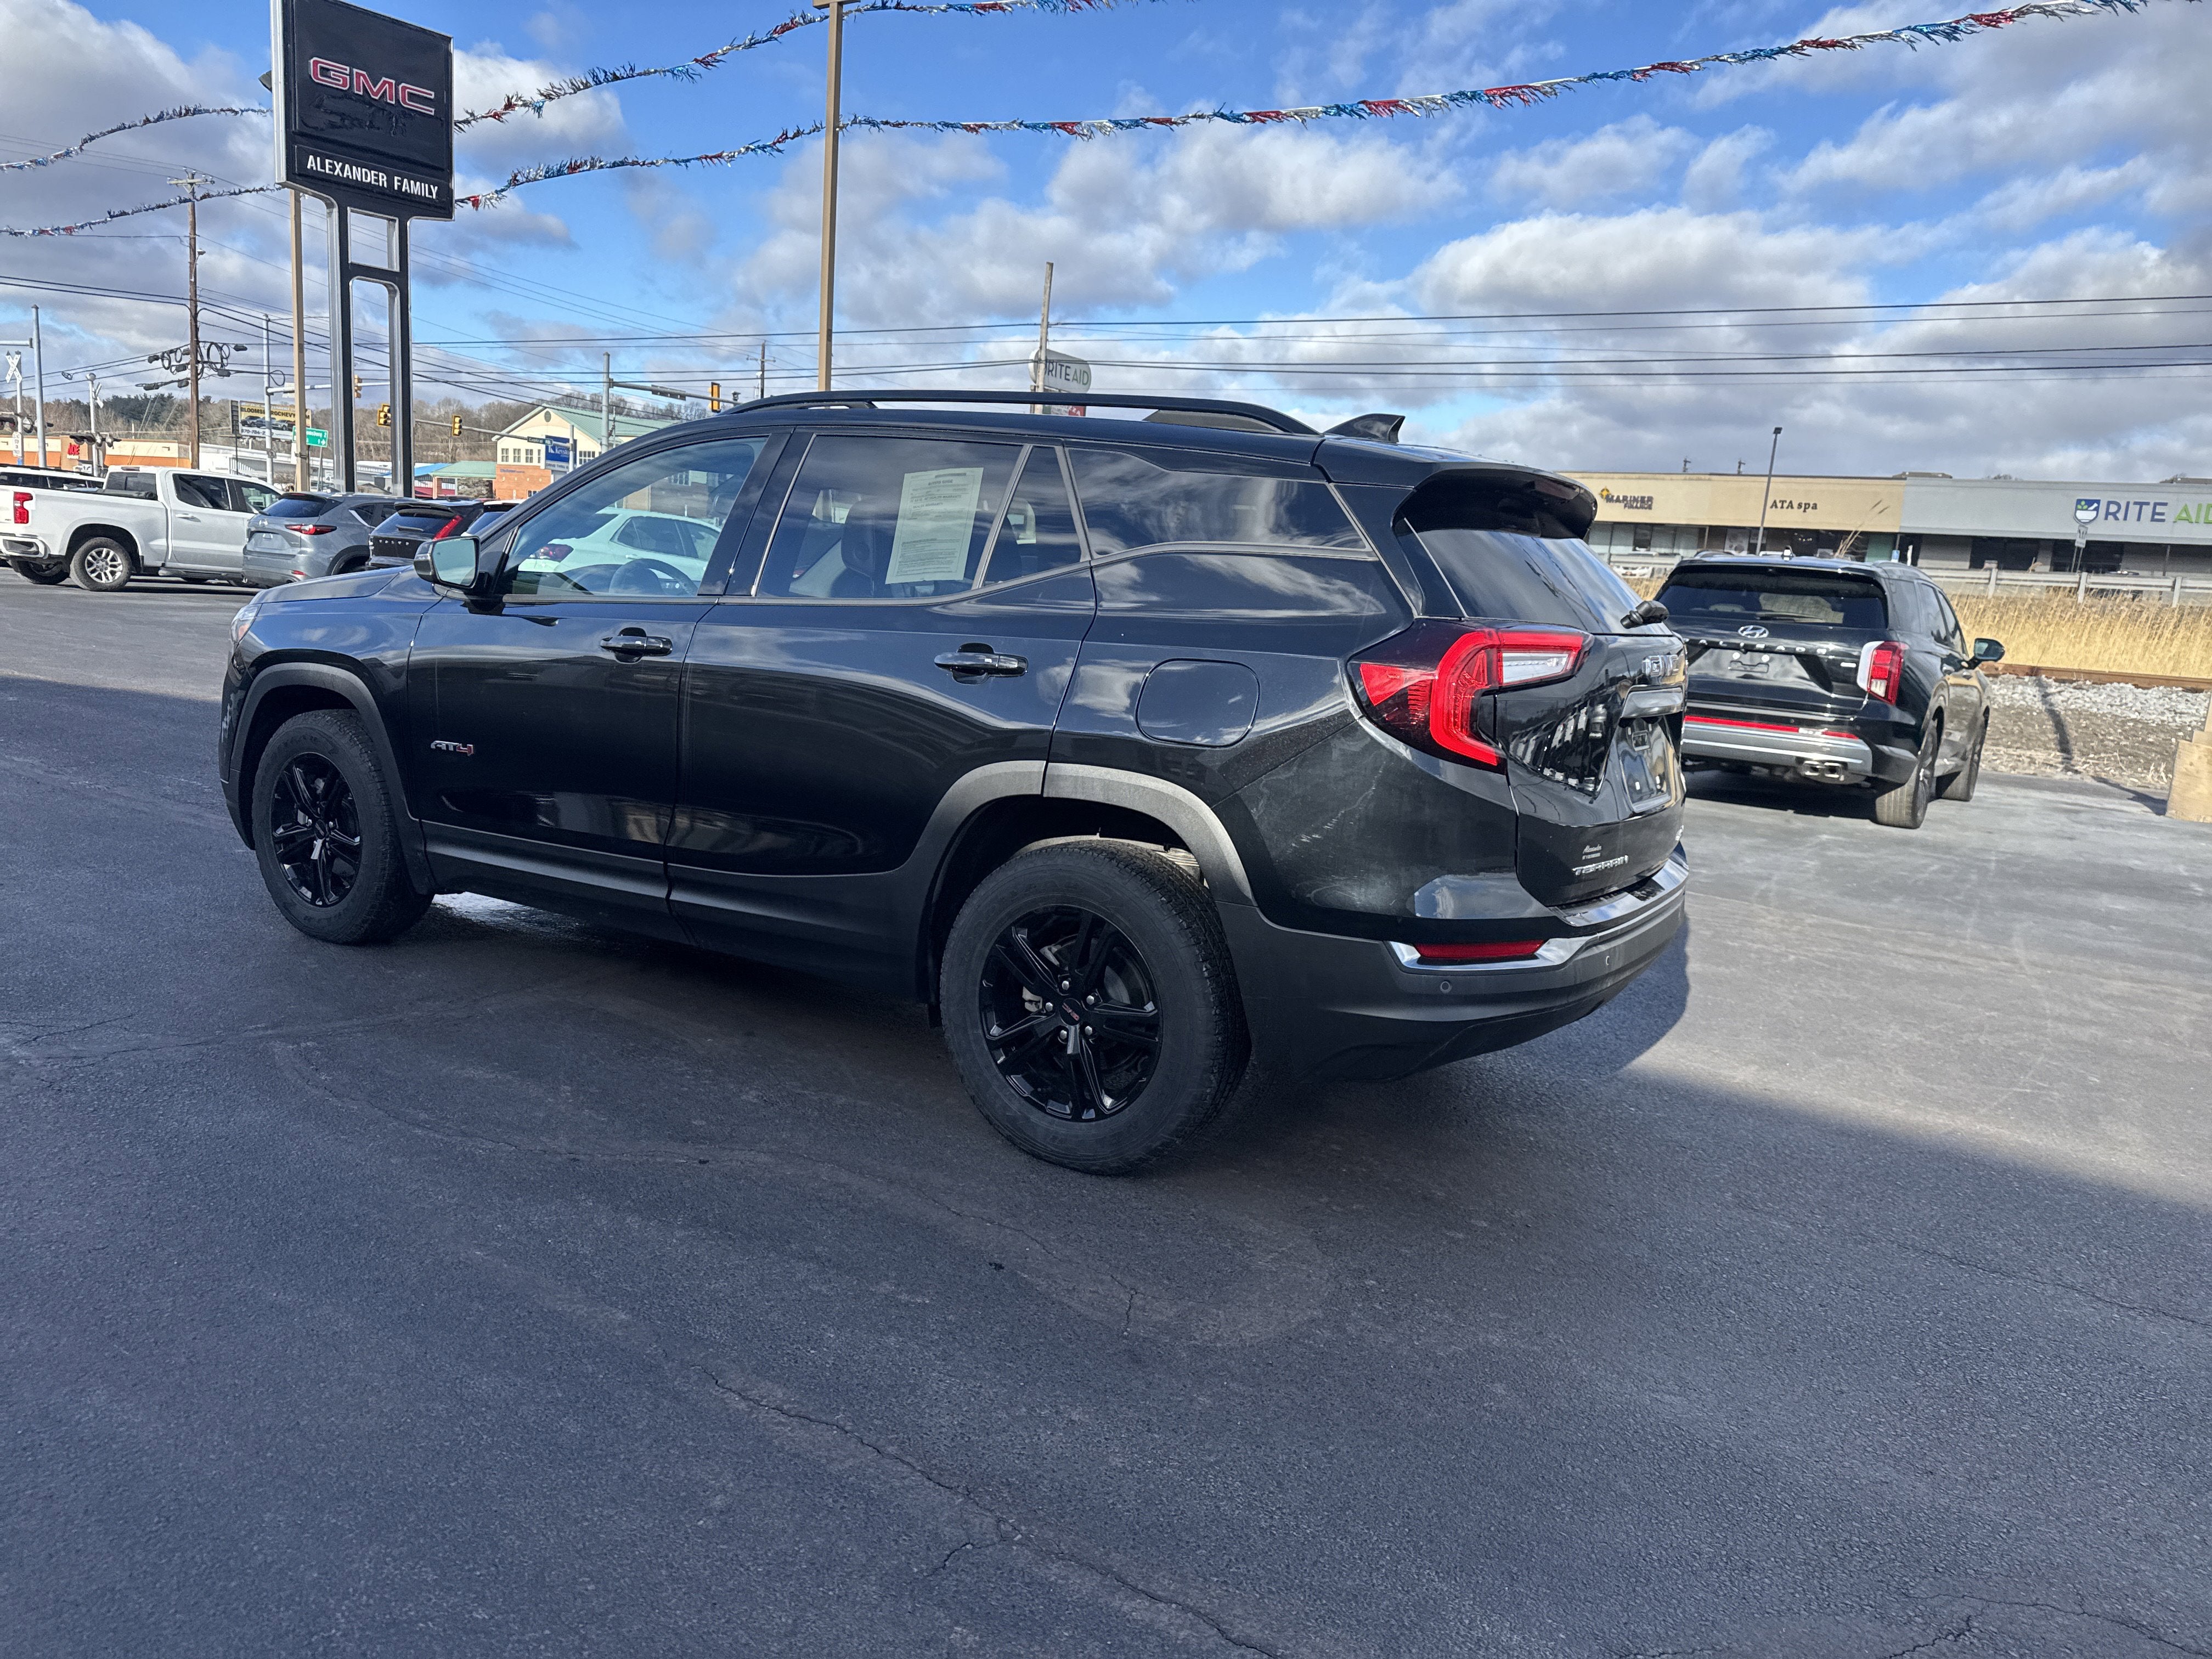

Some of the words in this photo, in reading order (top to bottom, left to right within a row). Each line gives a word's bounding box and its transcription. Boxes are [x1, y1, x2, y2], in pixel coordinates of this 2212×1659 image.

[309, 57, 435, 116] GMC
[307, 155, 387, 188] ALEXANDER
[394, 176, 438, 199] FAMILY
[1047, 359, 1071, 381] RITE
[1071, 368, 1090, 386] AID
[67, 444, 80, 455] ACE
[1606, 495, 1654, 504] MARINER
[1770, 499, 1794, 509] ATA
[1797, 502, 1818, 512] spa
[2104, 500, 2168, 522] RITE
[431, 740, 474, 757] AT4
[1571, 855, 1629, 876] TERRAIN
